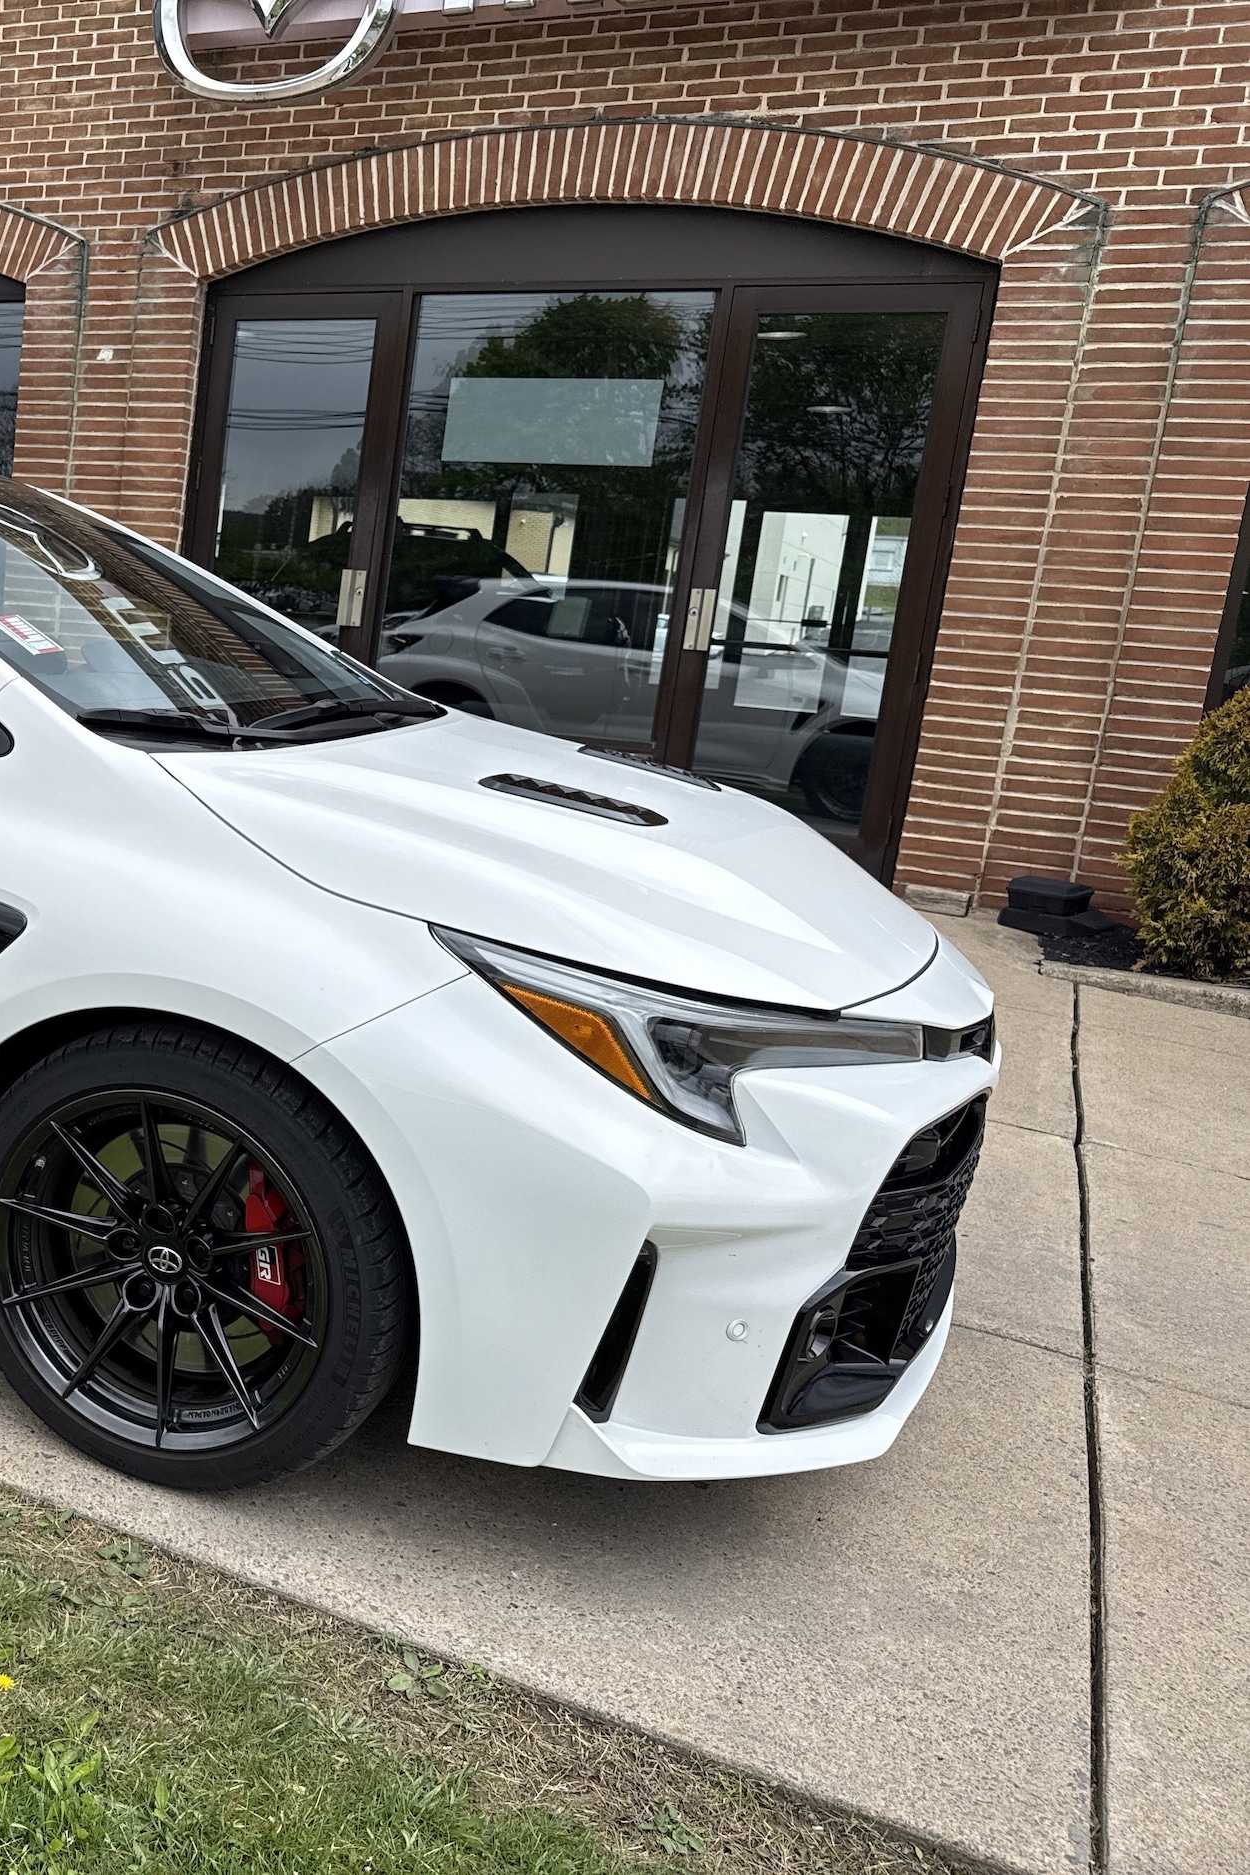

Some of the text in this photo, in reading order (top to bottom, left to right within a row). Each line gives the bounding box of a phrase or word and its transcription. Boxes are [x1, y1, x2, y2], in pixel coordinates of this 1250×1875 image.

[257, 1246, 272, 1280] GR
[335, 1248, 361, 1380] MICHELIN
[316, 1393, 337, 1421] PILOT
[285, 1423, 315, 1450] SPORT
